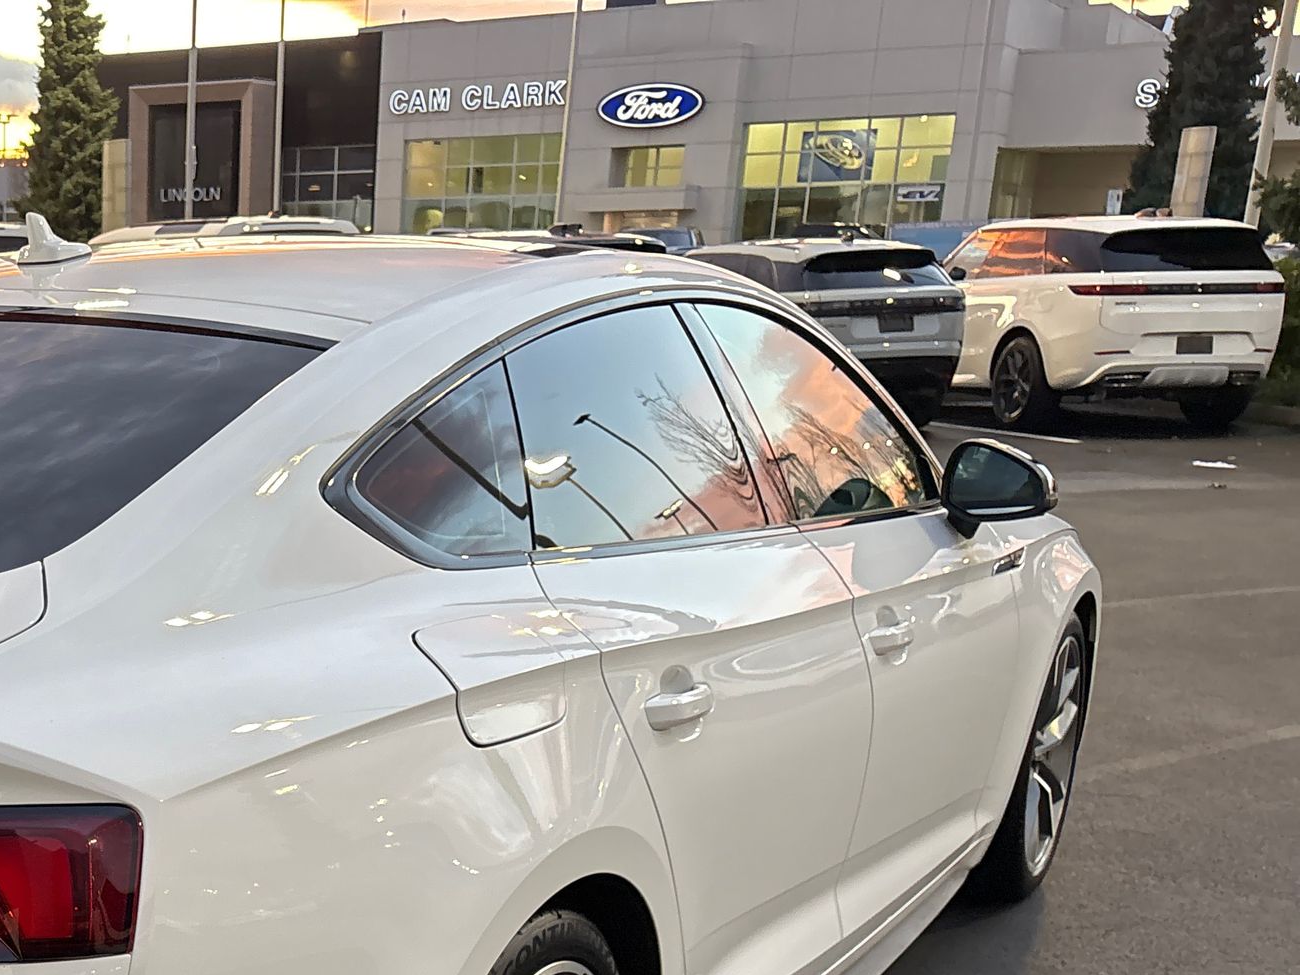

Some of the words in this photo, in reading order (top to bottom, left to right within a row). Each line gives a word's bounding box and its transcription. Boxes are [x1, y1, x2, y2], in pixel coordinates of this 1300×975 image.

[390, 88, 450, 114] CAM
[462, 80, 566, 110] CLARK
[617, 90, 682, 120] Ford
